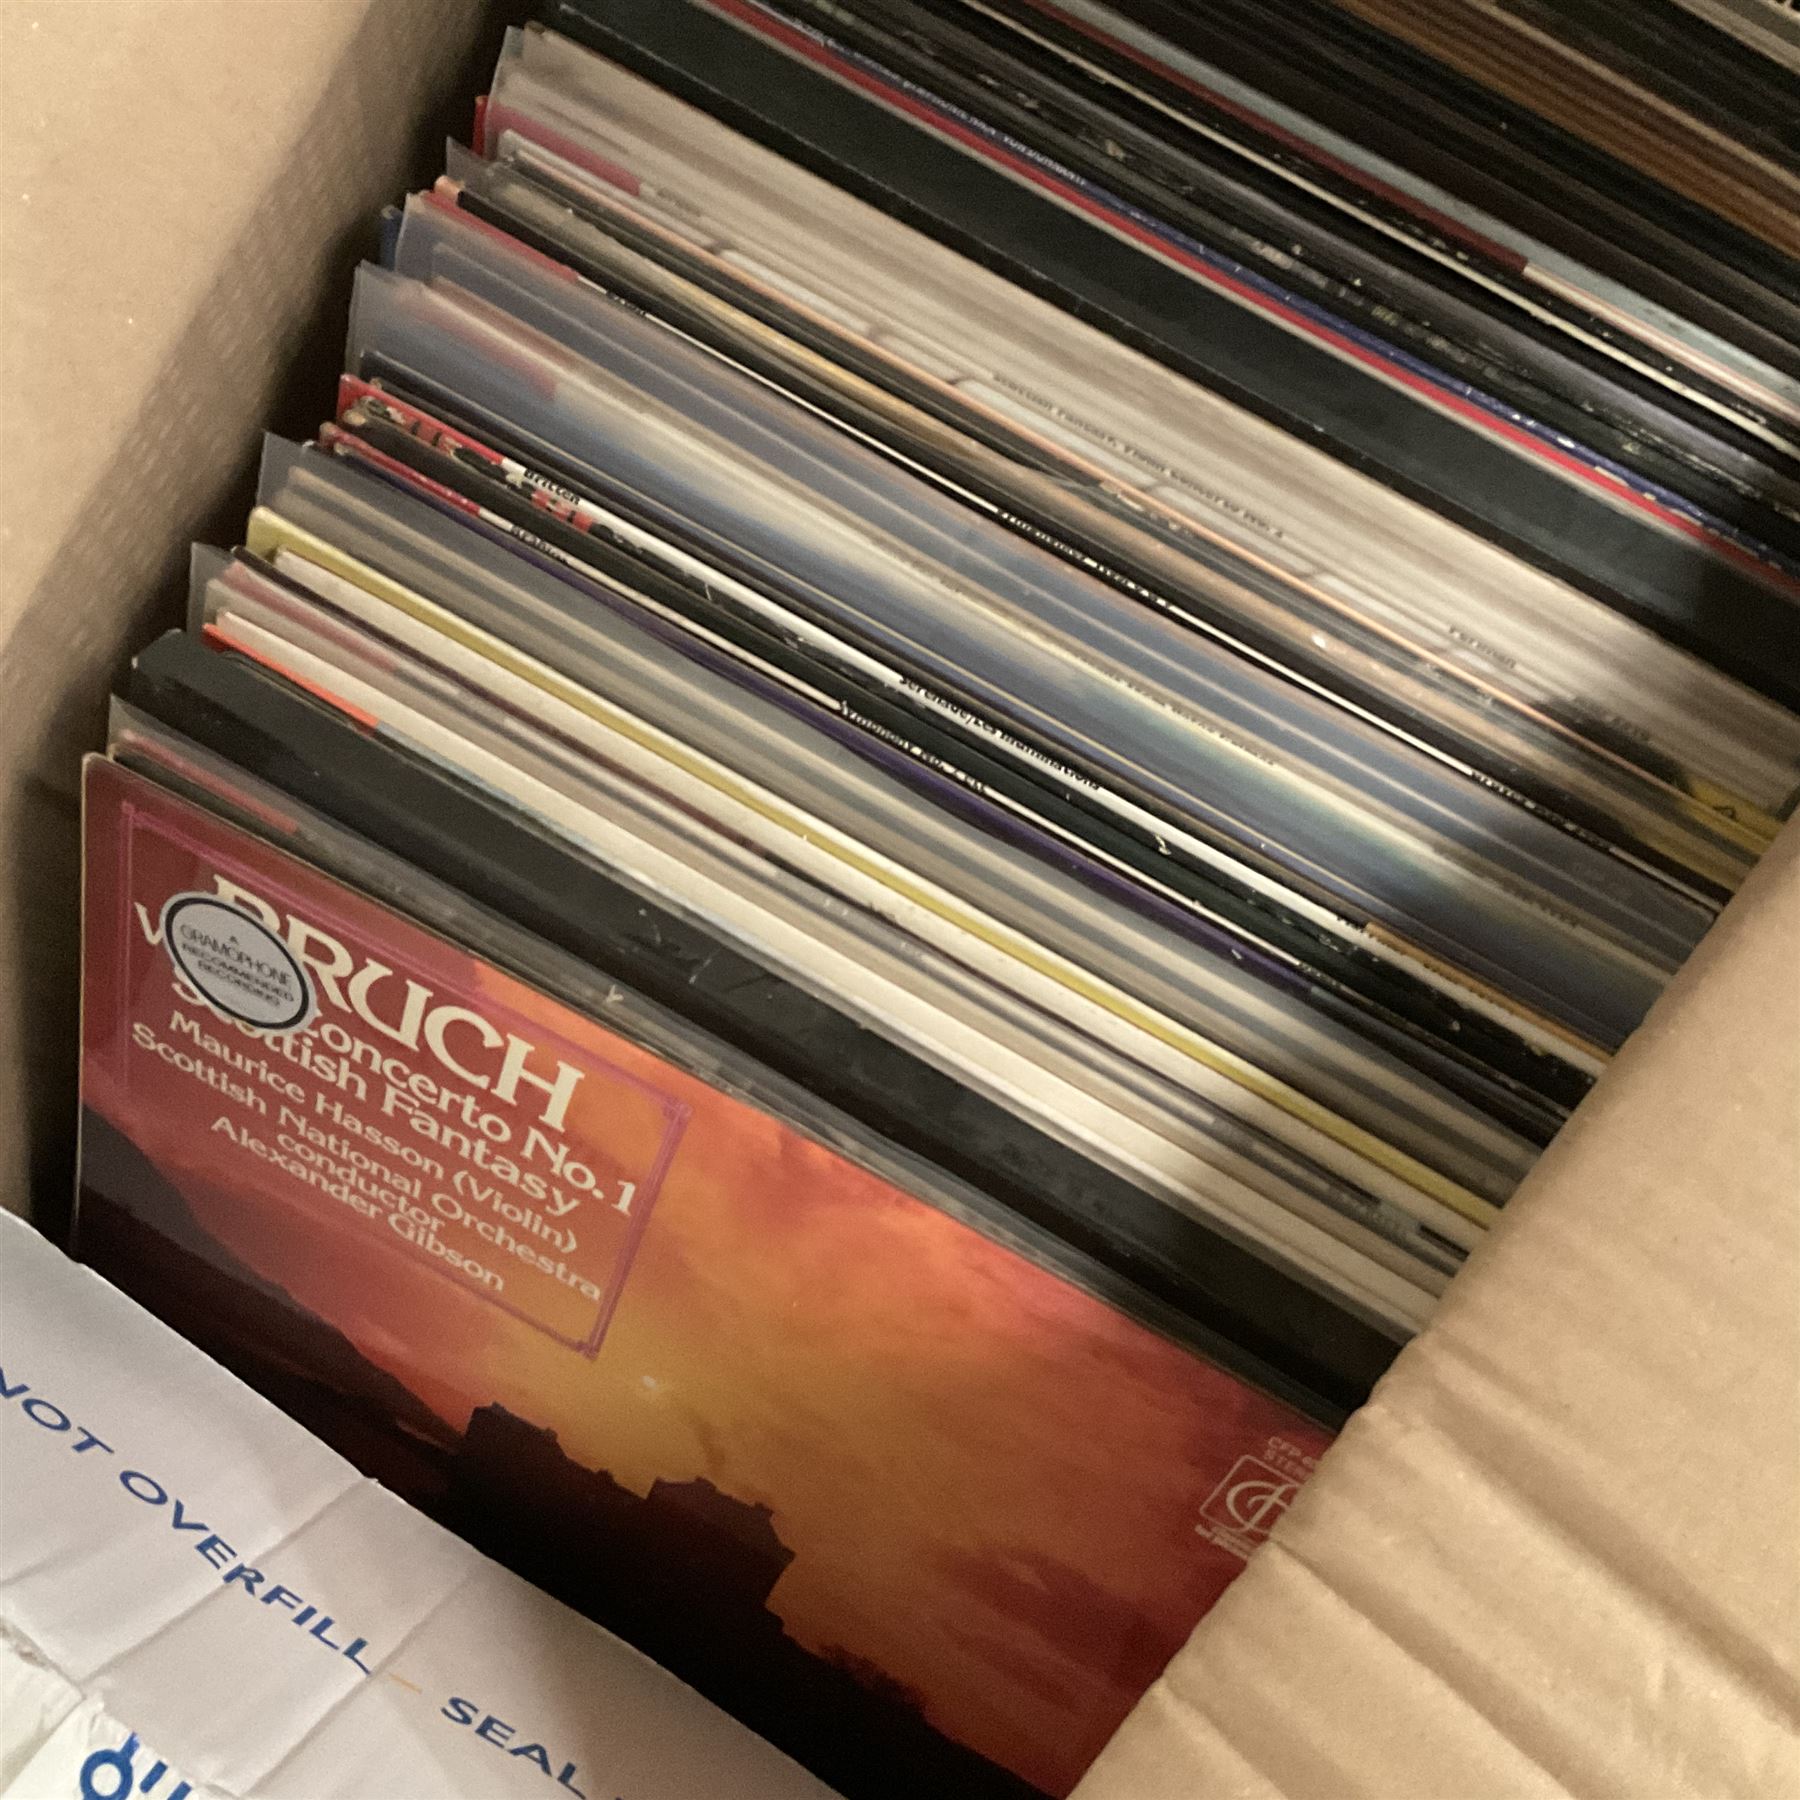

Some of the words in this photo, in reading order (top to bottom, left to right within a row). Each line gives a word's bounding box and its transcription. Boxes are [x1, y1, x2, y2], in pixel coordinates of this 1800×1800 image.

[180, 924, 291, 985] GRAMOPHONE
[132, 1022, 268, 1116] Scottish
[277, 1104, 423, 1201] National
[430, 1192, 602, 1302] Orchestra
[169, 1010, 306, 1104] Maurice
[314, 1091, 445, 1181] Hasson
[453, 1169, 578, 1255] (Violin)
[172, 980, 368, 1102] ttish
[380, 1080, 582, 1217] Fantasy
[210, 1116, 384, 1220] Alexander
[387, 1212, 505, 1292] Gibson
[277, 1132, 446, 1234] conductor
[302, 1007, 512, 1143] oncerto
[520, 1125, 605, 1201] No.
[611, 1179, 636, 1217] 1
[119, 1469, 371, 1677] OVERFILL
[440, 1696, 586, 1800] SEAL
